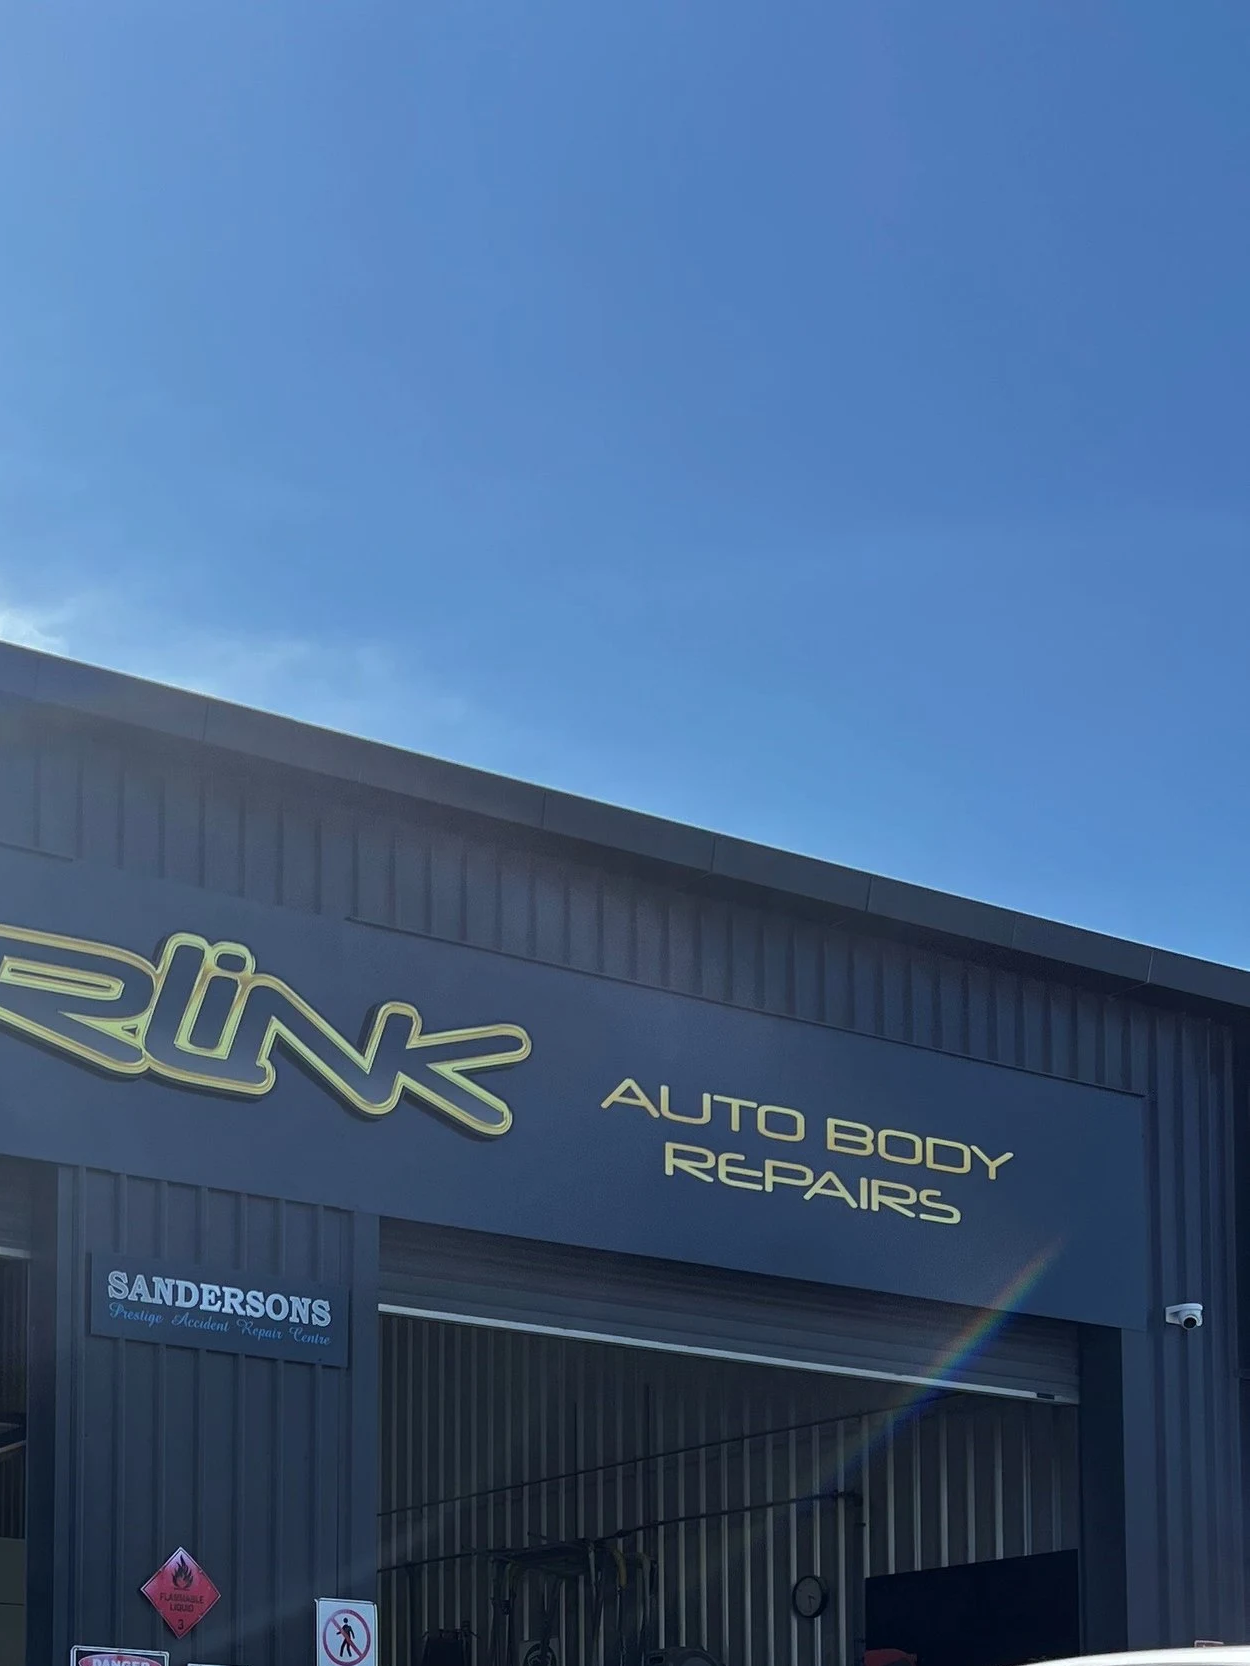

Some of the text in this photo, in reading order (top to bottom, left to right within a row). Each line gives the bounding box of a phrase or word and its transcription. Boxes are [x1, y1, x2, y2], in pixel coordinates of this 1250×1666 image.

[600, 1078, 1014, 1180] AUTO BODY
[665, 1141, 962, 1225] REPAIRS
[107, 1270, 332, 1327] SANDERSONS
[109, 1302, 331, 1346] Prestige Accident Repair Centre
[159, 1592, 204, 1604] FLAMMABLE
[170, 1603, 194, 1612] LIQUID
[177, 1618, 184, 1630] 3
